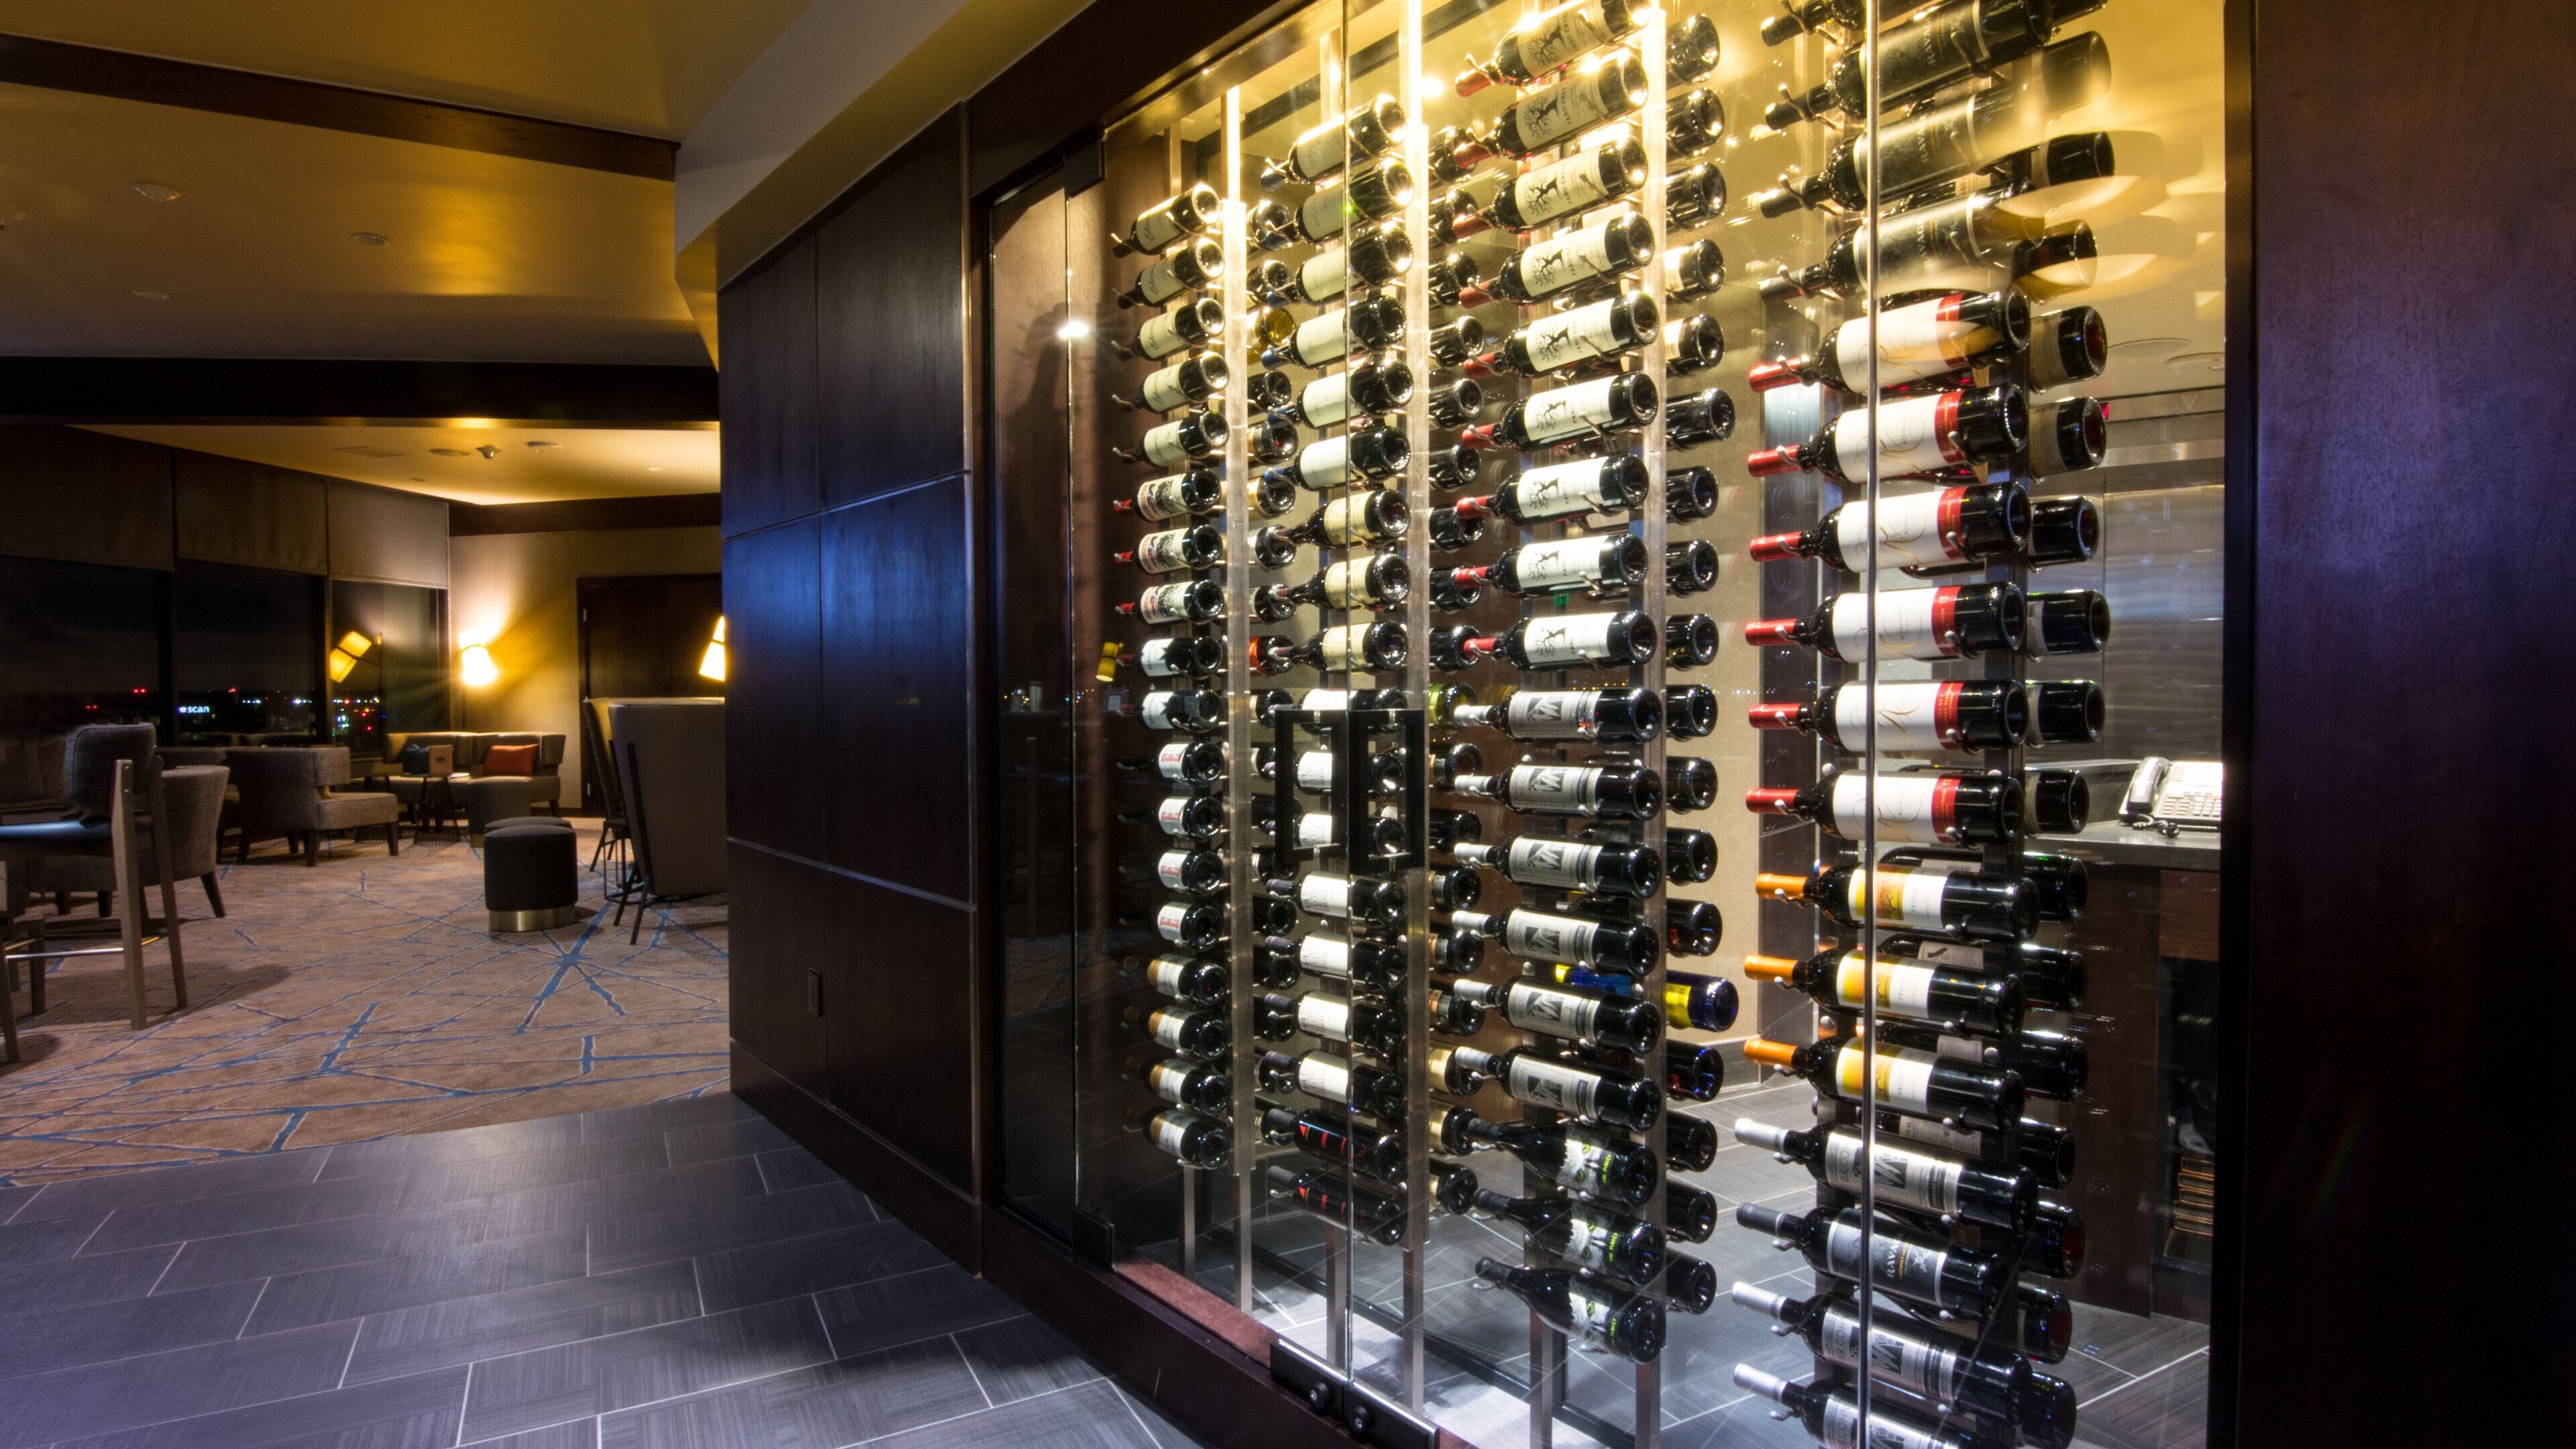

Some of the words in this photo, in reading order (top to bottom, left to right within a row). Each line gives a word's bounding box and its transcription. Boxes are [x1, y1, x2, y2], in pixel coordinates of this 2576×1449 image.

[1567, 34, 1579, 51] PASO
[1562, 107, 1572, 124] PASO
[1562, 186, 1573, 204] PASO
[1567, 258, 1577, 276] PASO
[1573, 337, 1583, 354] PASO
